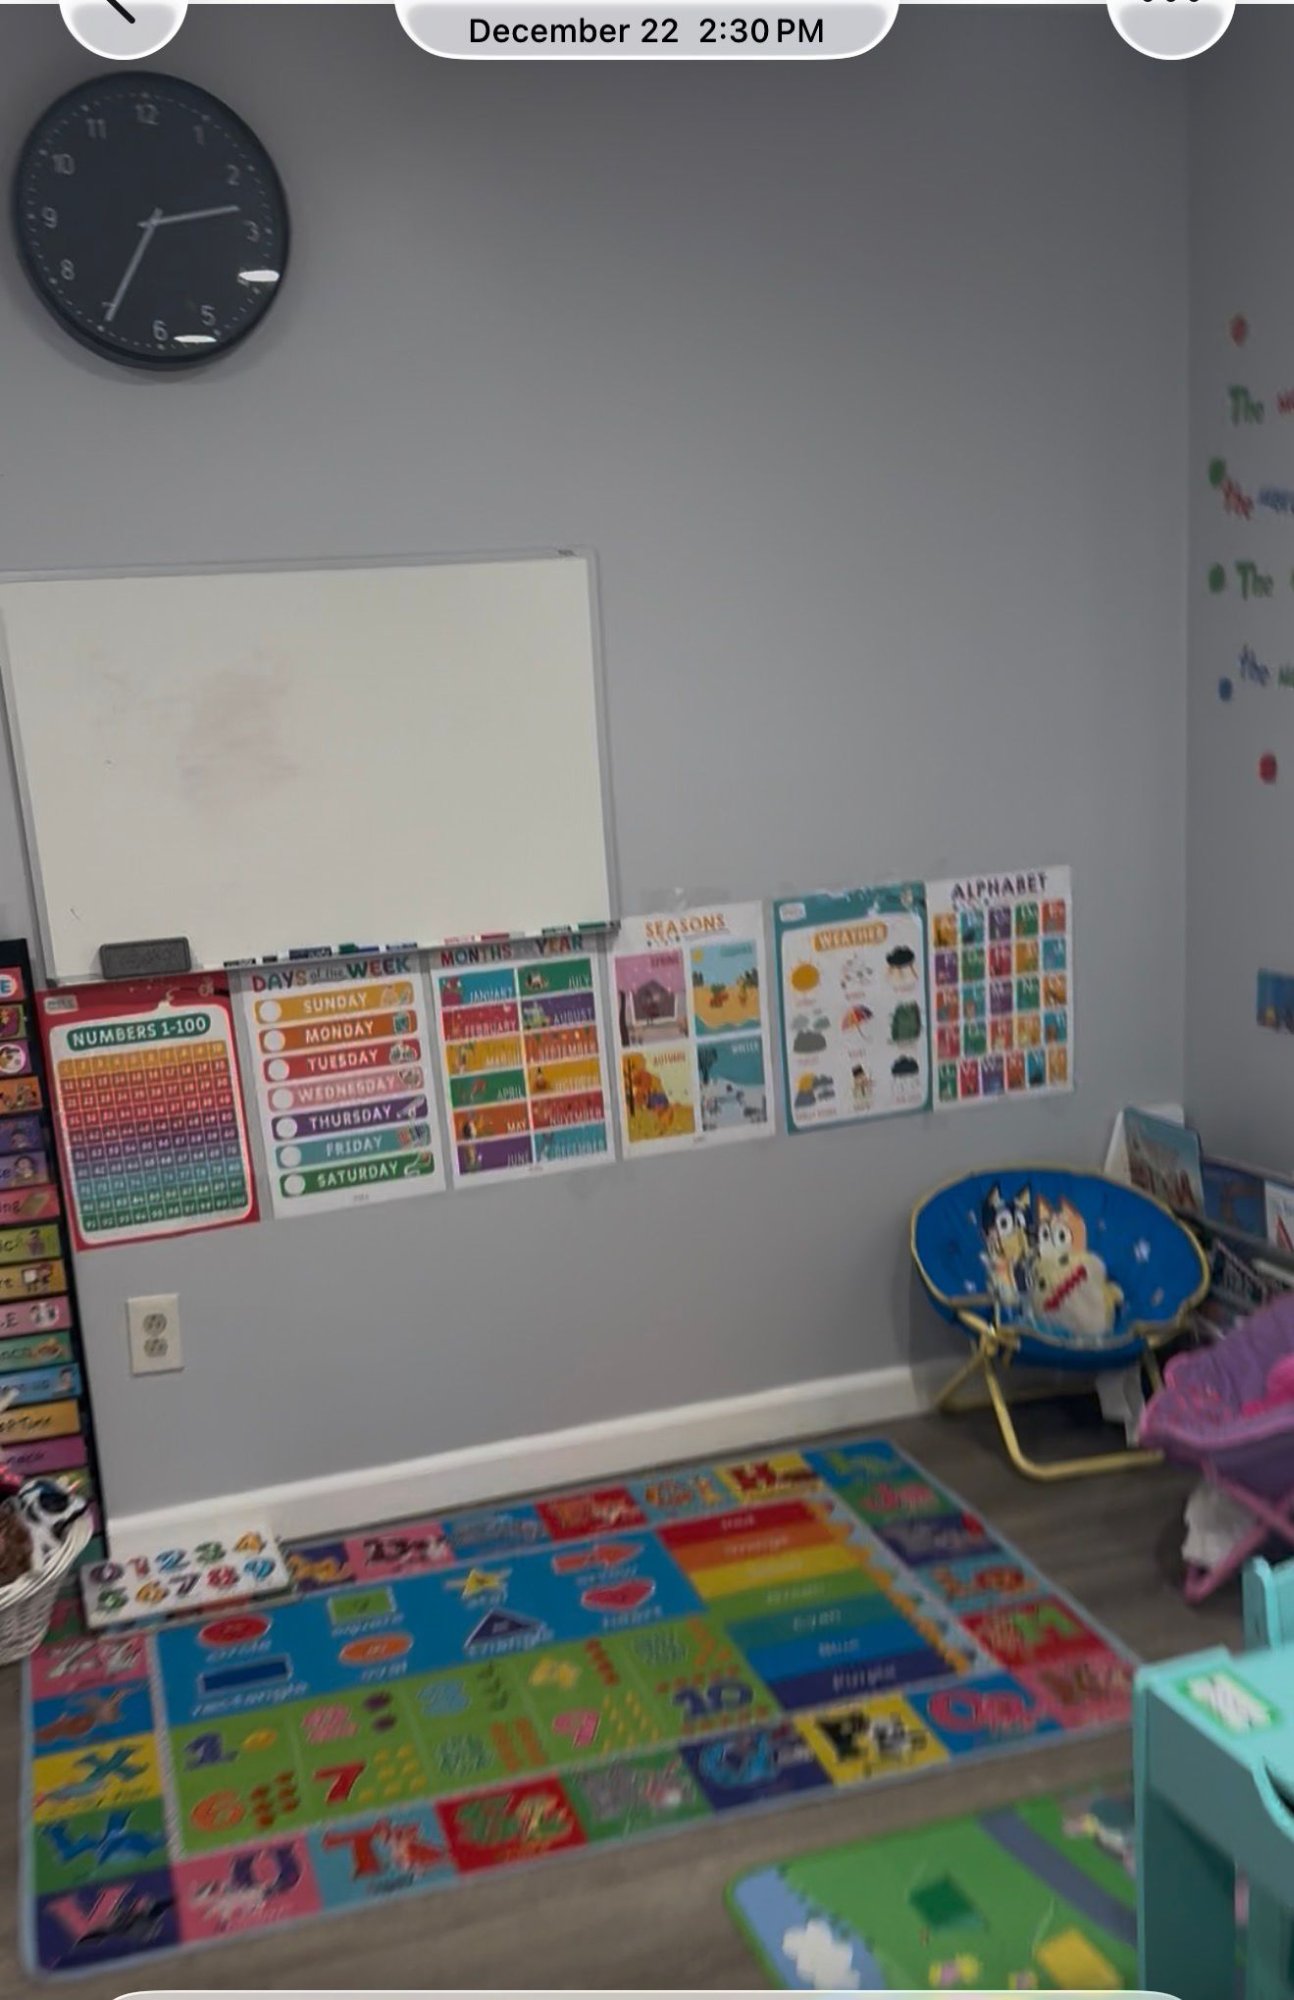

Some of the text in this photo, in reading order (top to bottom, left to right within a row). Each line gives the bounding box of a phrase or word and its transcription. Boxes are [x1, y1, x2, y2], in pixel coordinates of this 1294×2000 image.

[85, 118, 107, 139] 11
[53, 153, 75, 175] 10
[226, 165, 241, 187] 2
[42, 207, 58, 229] 9
[60, 259, 75, 281] 8
[200, 304, 216, 328] 5
[152, 320, 168, 342] 6
[951, 871, 1048, 901] ALPHABET
[644, 912, 726, 938] SEASONS
[252, 969, 308, 993] DAYS
[345, 956, 411, 980] WEEK
[303, 993, 367, 1013] SUNDAY
[72, 1016, 206, 1047] NUMBERS 1-100
[305, 1022, 374, 1043] MONDAY
[307, 1050, 379, 1072] TUESDAY
[298, 1074, 397, 1103] WEDNESDAY
[309, 1105, 392, 1131] THURSDAY
[326, 1136, 383, 1157] FRIDAY
[317, 1161, 399, 1189] SATURDAY
[313, 1761, 366, 1804] 7
